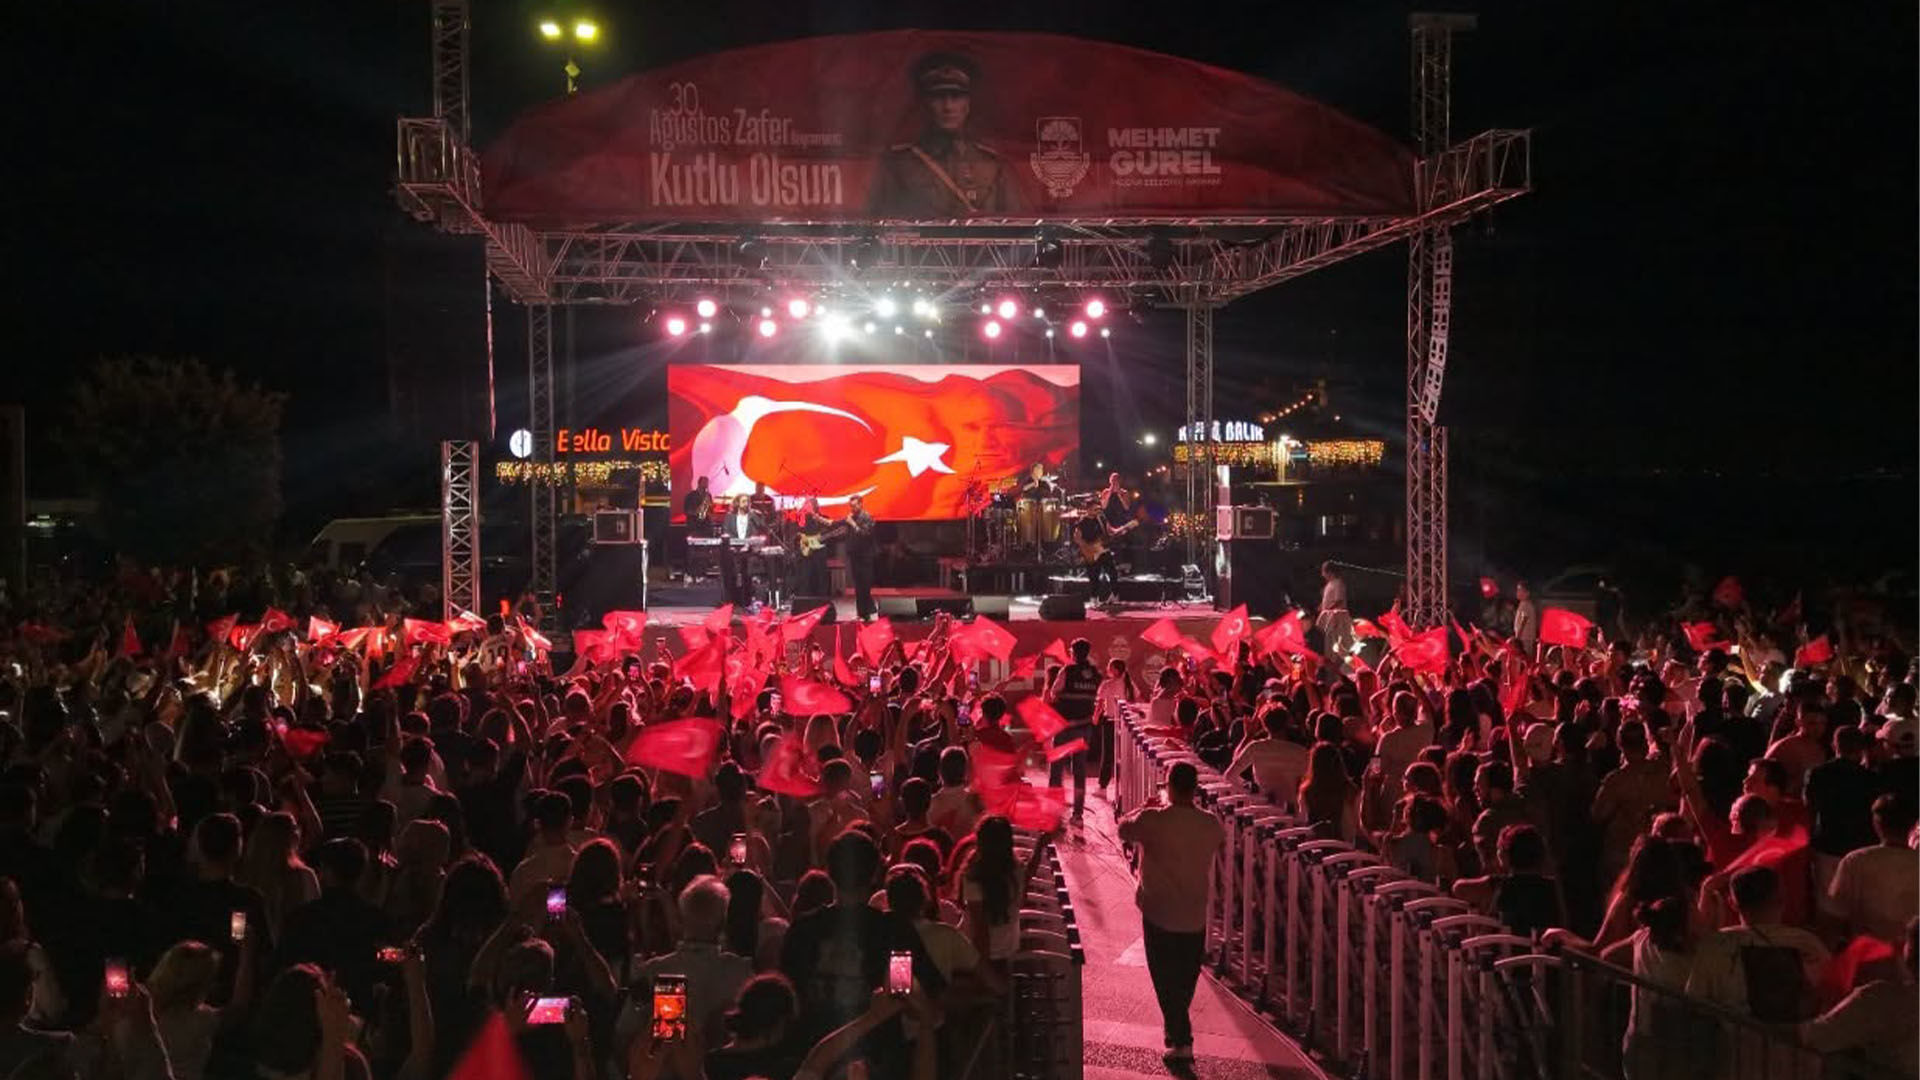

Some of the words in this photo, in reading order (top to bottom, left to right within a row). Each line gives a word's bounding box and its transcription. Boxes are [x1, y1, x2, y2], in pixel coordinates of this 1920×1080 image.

[669, 82, 698, 116] 30
[651, 109, 730, 149] Ağustos
[733, 108, 792, 145] Zafer
[1107, 127, 1221, 148] MEHMET
[651, 152, 740, 206] Kutlu
[750, 152, 844, 206] Olsun
